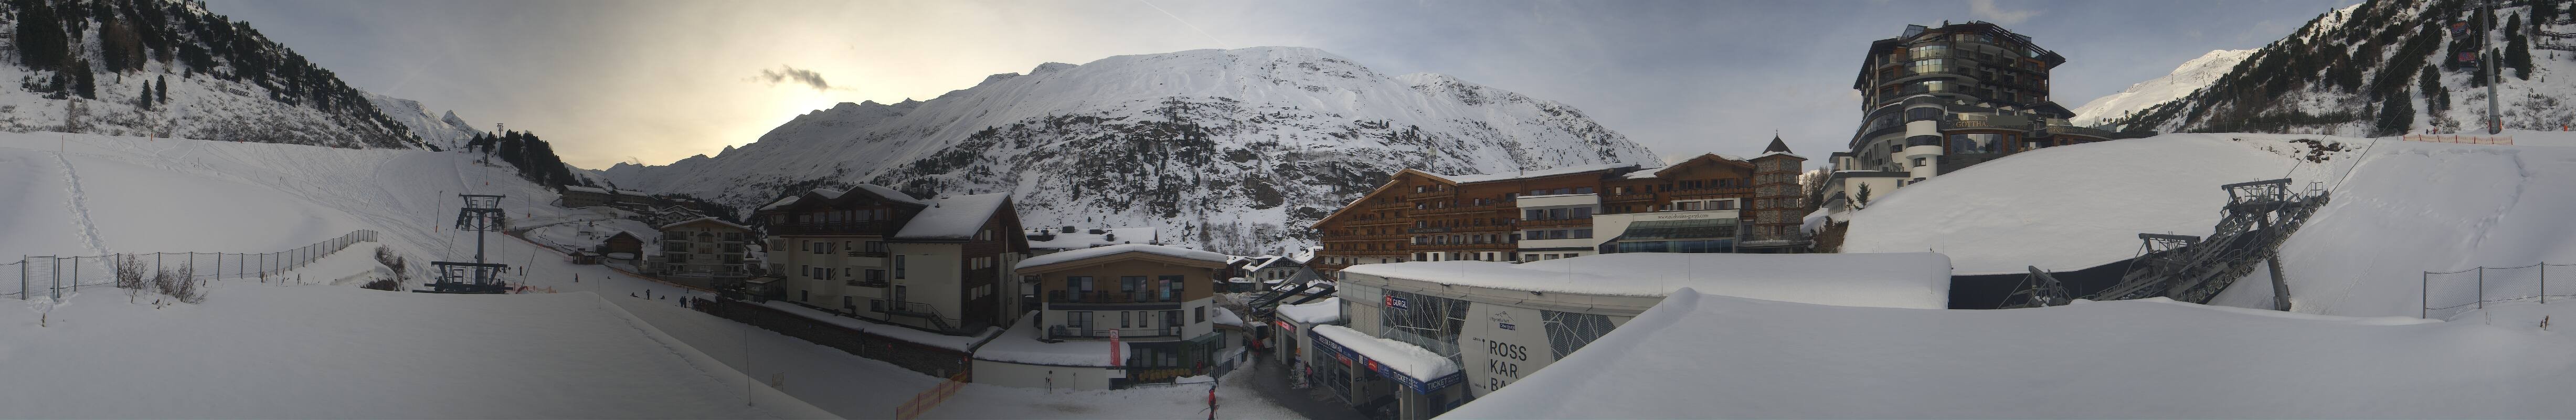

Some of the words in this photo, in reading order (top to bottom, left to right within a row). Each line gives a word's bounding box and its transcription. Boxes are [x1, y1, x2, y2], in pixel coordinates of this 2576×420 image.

[1393, 299, 1407, 308] GURGL
[1319, 335, 1342, 353] ROSSKARBAHN
[1490, 340, 1527, 361] ROSS
[1490, 359, 1518, 379] KAR
[1393, 371, 1408, 384] TICKET
[1427, 377, 1448, 390] TICKET
[1491, 377, 1512, 392] BA
